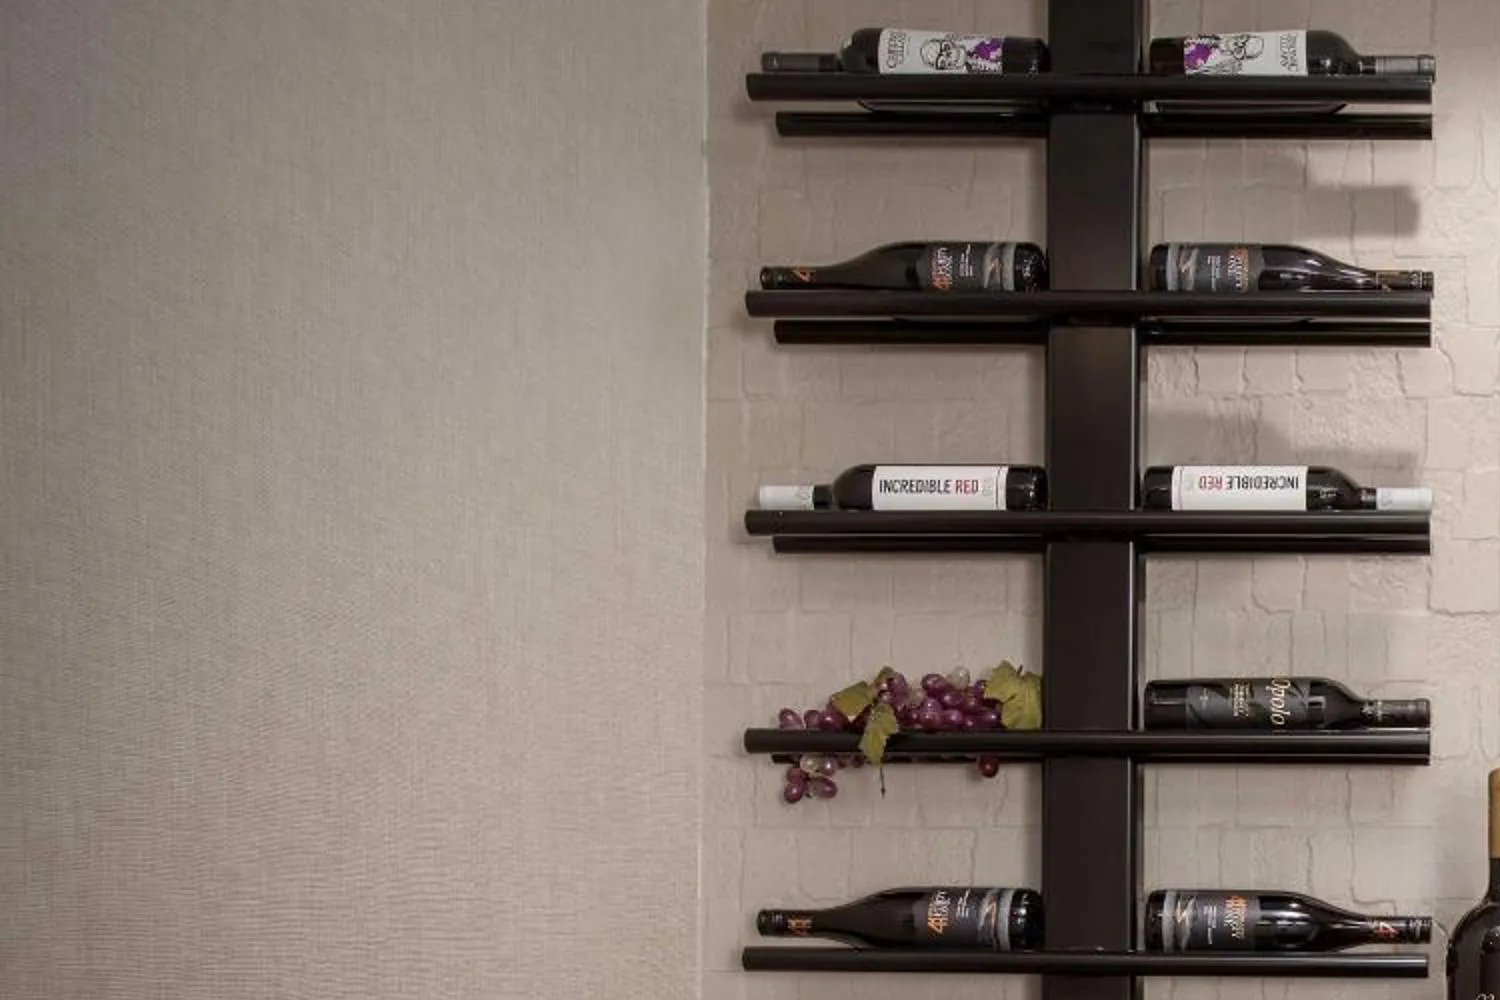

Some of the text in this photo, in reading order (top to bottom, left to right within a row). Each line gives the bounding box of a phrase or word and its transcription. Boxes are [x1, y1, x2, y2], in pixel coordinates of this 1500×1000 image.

[879, 479, 979, 495] INCREDIBLE RED
[1199, 475, 1299, 490] INCREDIBLE RED
